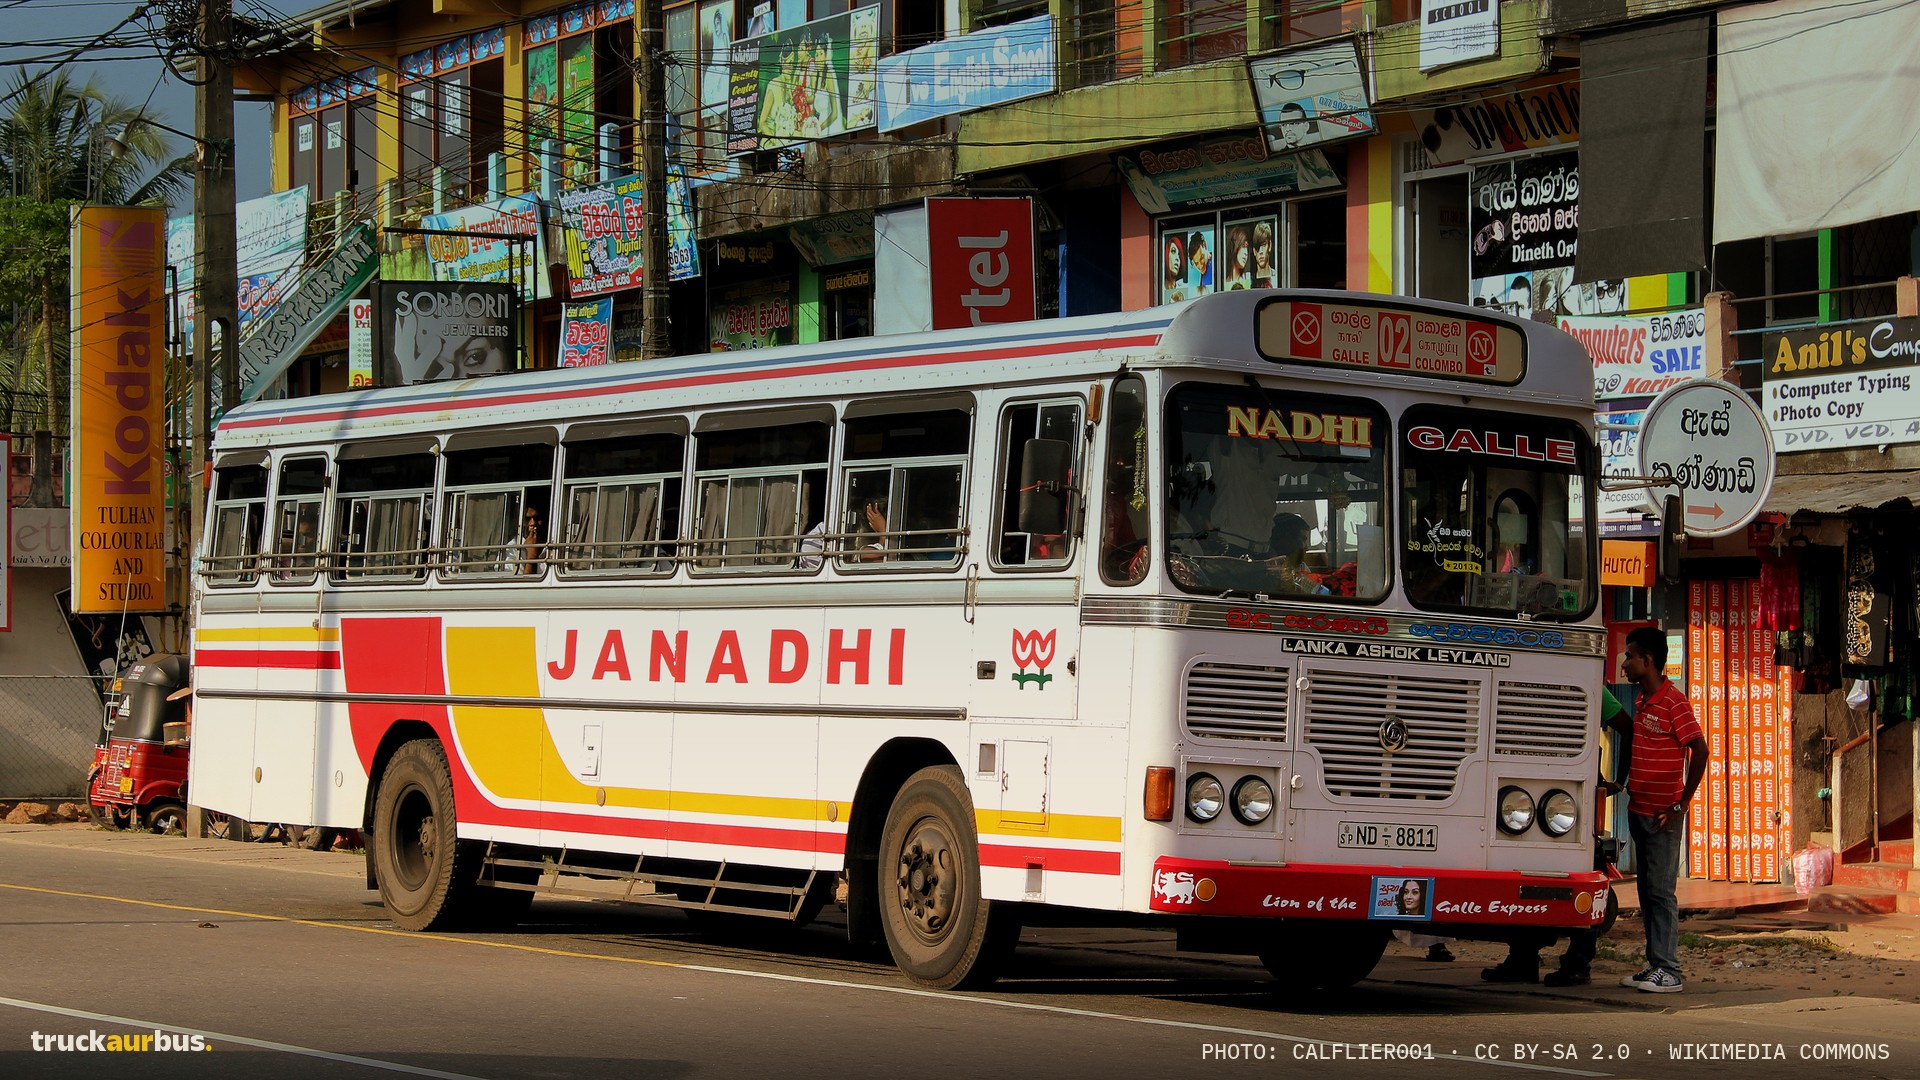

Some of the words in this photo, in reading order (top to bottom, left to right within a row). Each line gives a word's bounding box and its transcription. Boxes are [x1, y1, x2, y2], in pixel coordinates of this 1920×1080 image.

[1435, 1, 1481, 22] SCHOOL
[934, 51, 990, 104] English
[993, 37, 1048, 88] School
[731, 82, 757, 96] Center
[616, 237, 642, 256] Digital
[1512, 241, 1554, 263] Dineth
[247, 231, 374, 364] RESTAURANT
[395, 291, 509, 318] SORBORN
[442, 323, 509, 337] JEWELLERS
[1331, 310, 1371, 330] ගාල්ල
[1415, 320, 1462, 337] කොළඹ
[1380, 315, 1410, 364] 02
[1472, 337, 1490, 356] N
[1332, 348, 1369, 364] GALLE
[1650, 345, 1702, 374] SALE
[1771, 329, 1867, 373] Anil's
[1415, 357, 1463, 373] COLOMBO
[102, 286, 151, 494] Kodak
[1780, 379, 1852, 400] Computer
[1858, 374, 1911, 394] Typing
[1680, 400, 1732, 442] ඇස්
[1780, 405, 1821, 421] Photo
[1827, 400, 1864, 418] Copy
[1227, 405, 1372, 449] NADHI
[1785, 430, 1833, 446] DVD,
[1845, 424, 1894, 440] VCD,
[1407, 426, 1577, 465] GALLE
[1651, 454, 1756, 494] කණ්ණාඩි
[98, 506, 156, 524] TULHAN
[80, 532, 141, 550] COLOUR
[146, 533, 164, 550] LAB
[38, 556, 50, 564] No
[112, 558, 143, 575] AND
[1453, 562, 1473, 570] 2013
[99, 583, 154, 601] STUDIO.
[1225, 608, 1272, 630] බුදු
[547, 628, 906, 685] JANADHI
[1282, 639, 1348, 655] LANKA
[1356, 643, 1420, 660] ASHOK
[1428, 649, 1510, 667] LEYLAND
[1357, 825, 1377, 845] ND
[1396, 827, 1435, 848] 8811
[1263, 895, 1301, 908] Lion
[1307, 895, 1323, 911] of
[1330, 897, 1358, 910] the
[1436, 900, 1482, 914] Galle
[1487, 900, 1549, 915] Express
